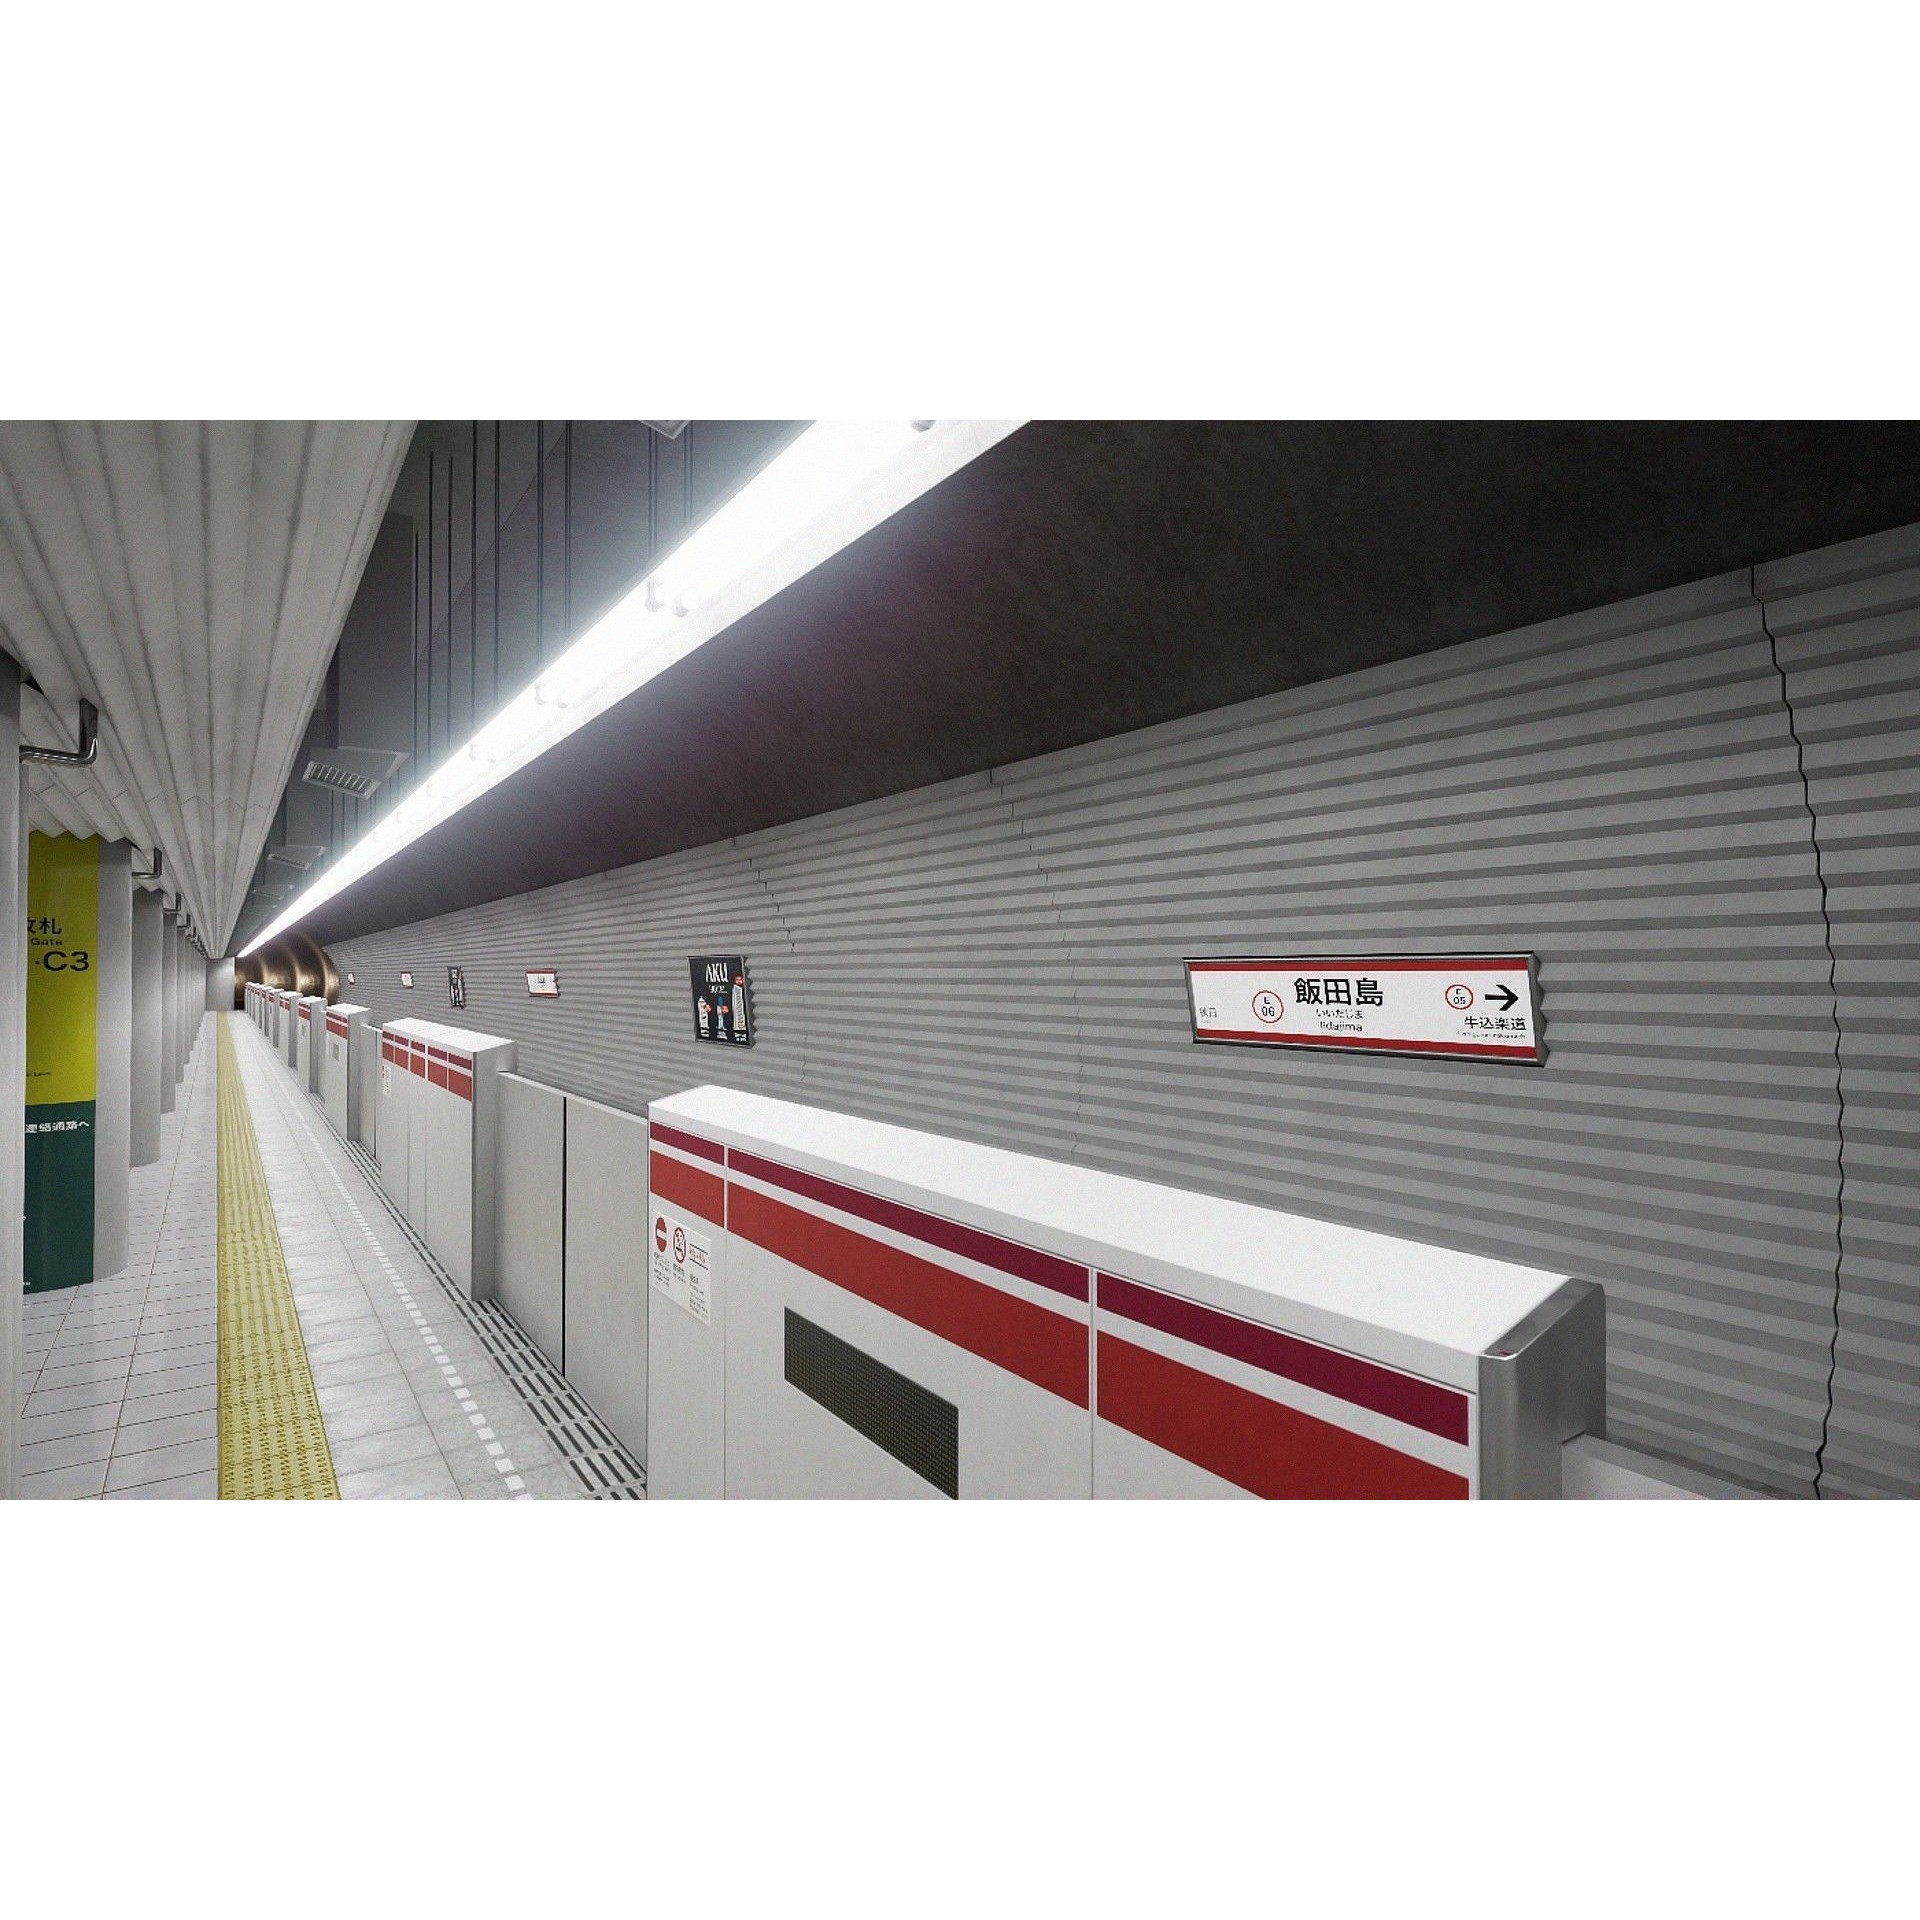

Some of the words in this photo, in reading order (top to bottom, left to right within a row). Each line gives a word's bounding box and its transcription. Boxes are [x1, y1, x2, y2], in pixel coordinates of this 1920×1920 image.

[1294, 977, 1383, 1006] 飯田島
[1453, 996, 1466, 1005] 05
[1261, 1006, 1275, 1017] 06
